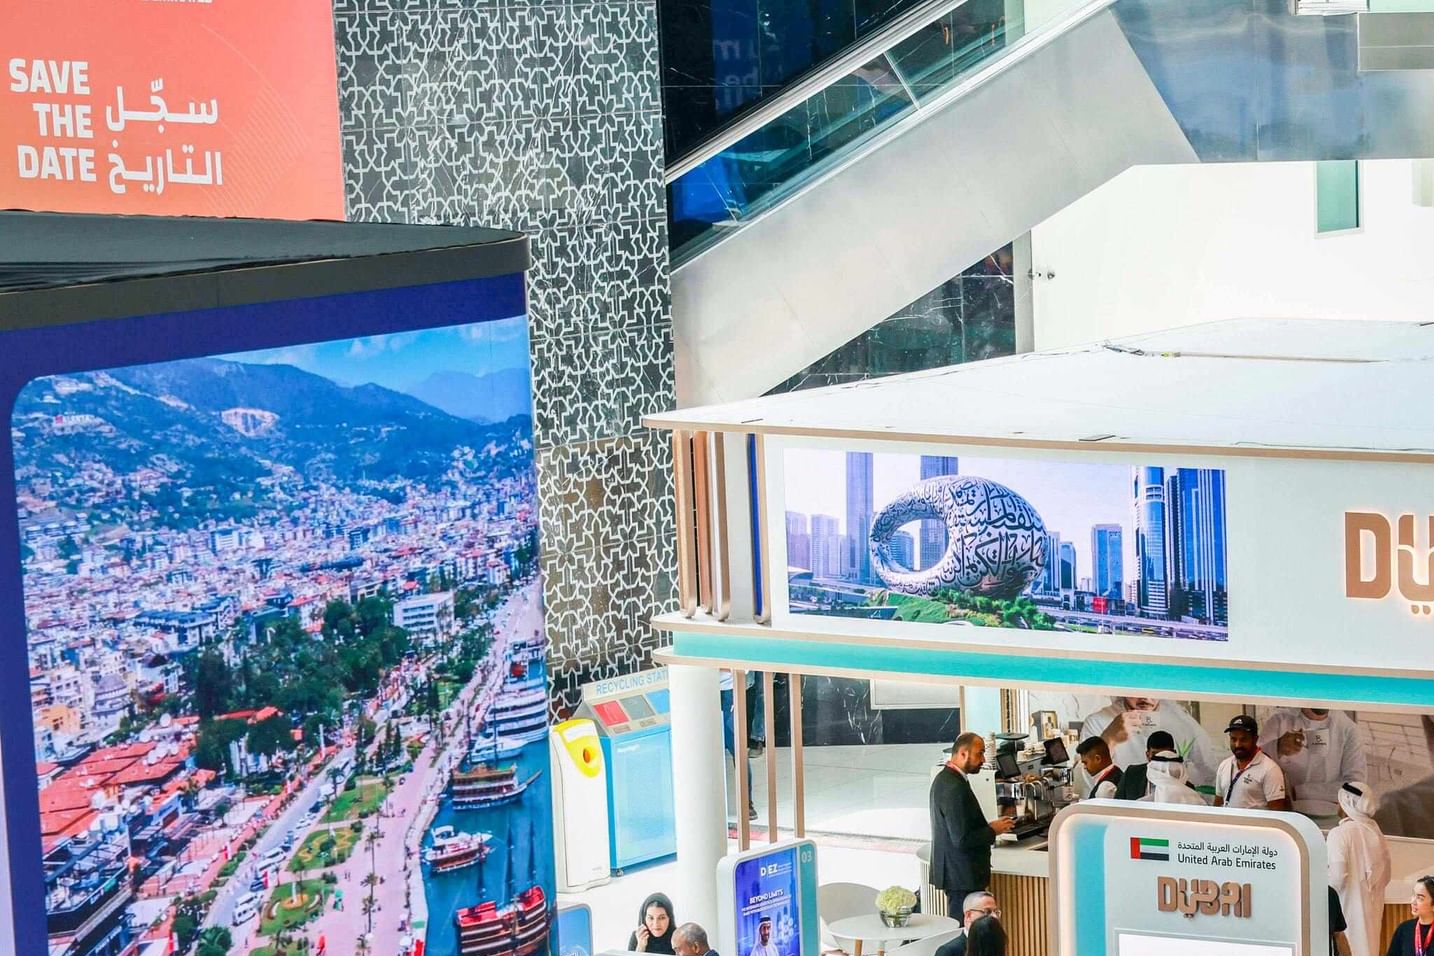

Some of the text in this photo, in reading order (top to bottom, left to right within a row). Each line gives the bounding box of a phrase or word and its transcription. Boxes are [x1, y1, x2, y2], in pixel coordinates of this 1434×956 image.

[9, 58, 90, 95] SAVE
[33, 103, 94, 138] THE
[18, 145, 97, 181] DATE
[107, 139, 222, 194] التاريخ
[596, 668, 668, 694] RECYCLING STATI
[801, 850, 812, 863] 03
[1177, 841, 1278, 858] دولة الإمارات العربية المتحدة
[1177, 853, 1276, 870] United Arab Emirates
[1157, 876, 1252, 918] DUBAI
